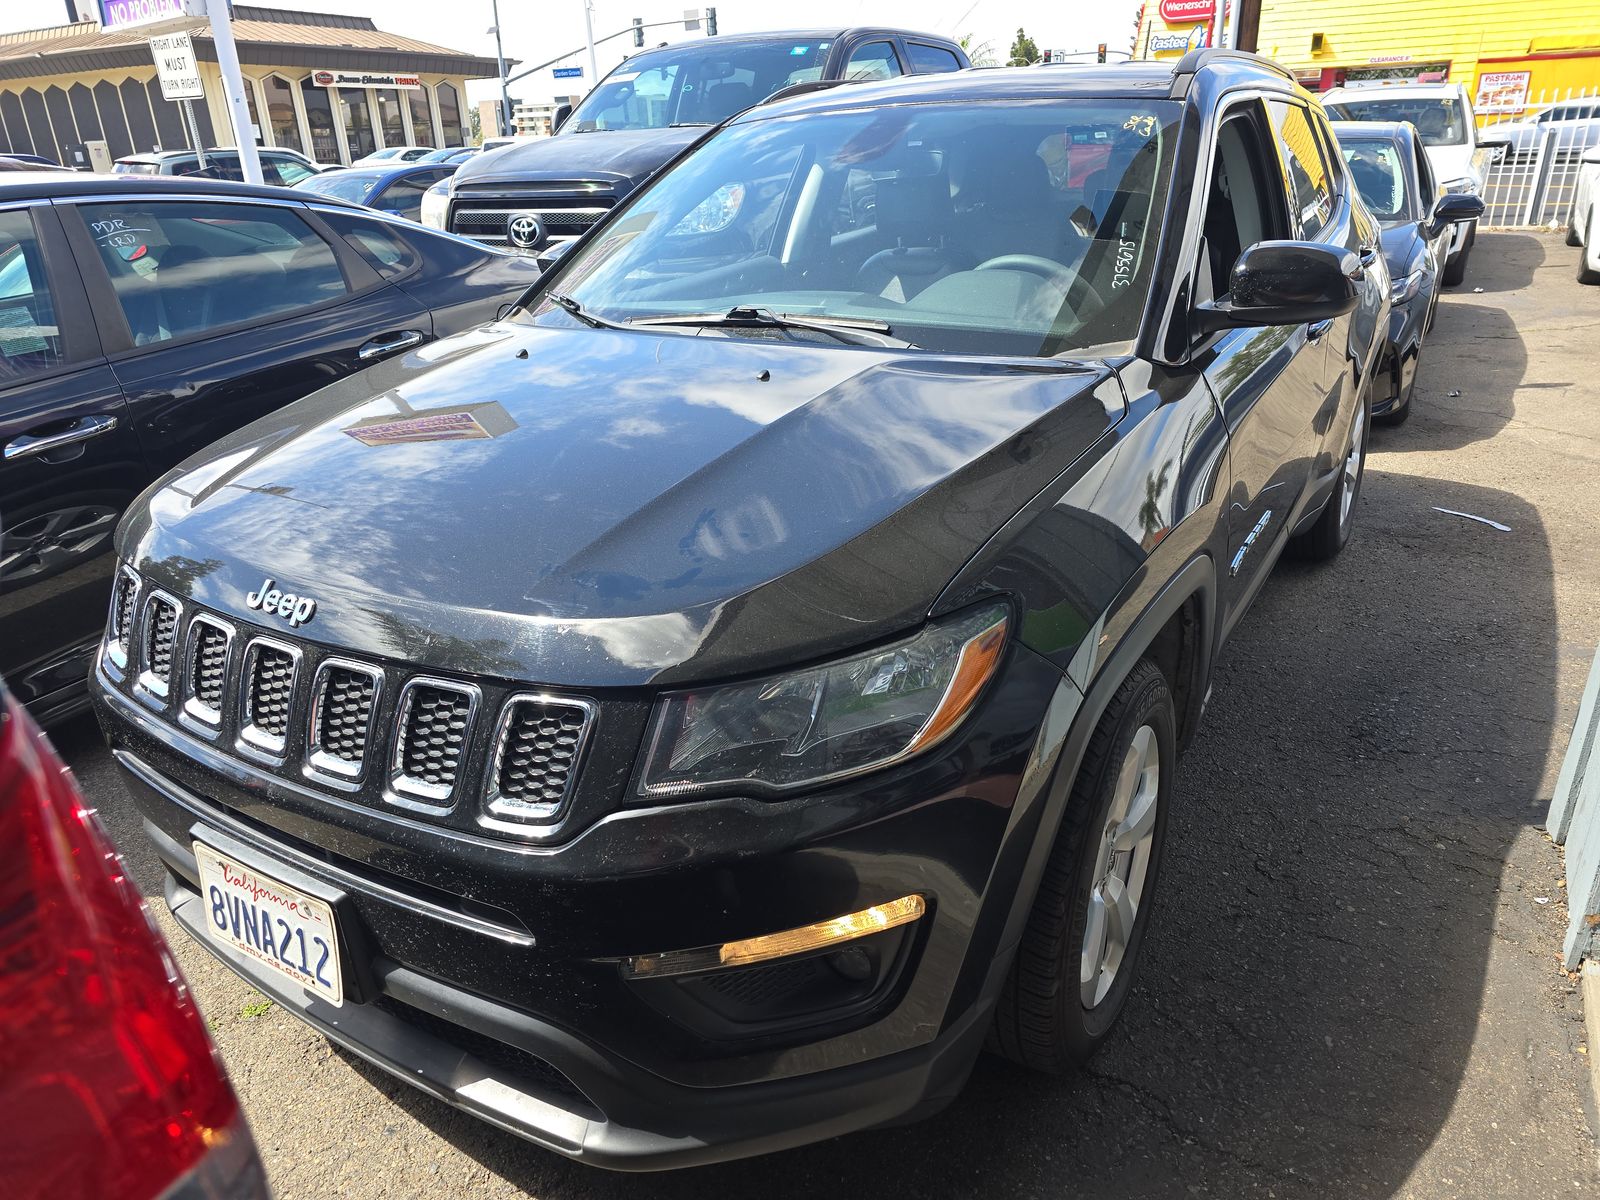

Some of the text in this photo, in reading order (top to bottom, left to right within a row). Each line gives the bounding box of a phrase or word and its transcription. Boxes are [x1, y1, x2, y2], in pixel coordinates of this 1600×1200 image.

[109, 0, 178, 24] NO PROBLEM
[152, 36, 189, 51] RIGHT LANE
[1151, 35, 1189, 51] tastee
[164, 56, 187, 71] MUST
[162, 77, 199, 90] TURN RIGHT
[394, 77, 420, 86] PAINTS
[1485, 74, 1525, 82] PASTRAMI
[91, 219, 131, 234] PDR
[1111, 238, 1136, 289] 3755675
[246, 579, 317, 629] Jeep
[222, 863, 310, 920] California
[209, 884, 332, 989] 8VNA212
[238, 942, 308, 983] dmv.ca.gov
